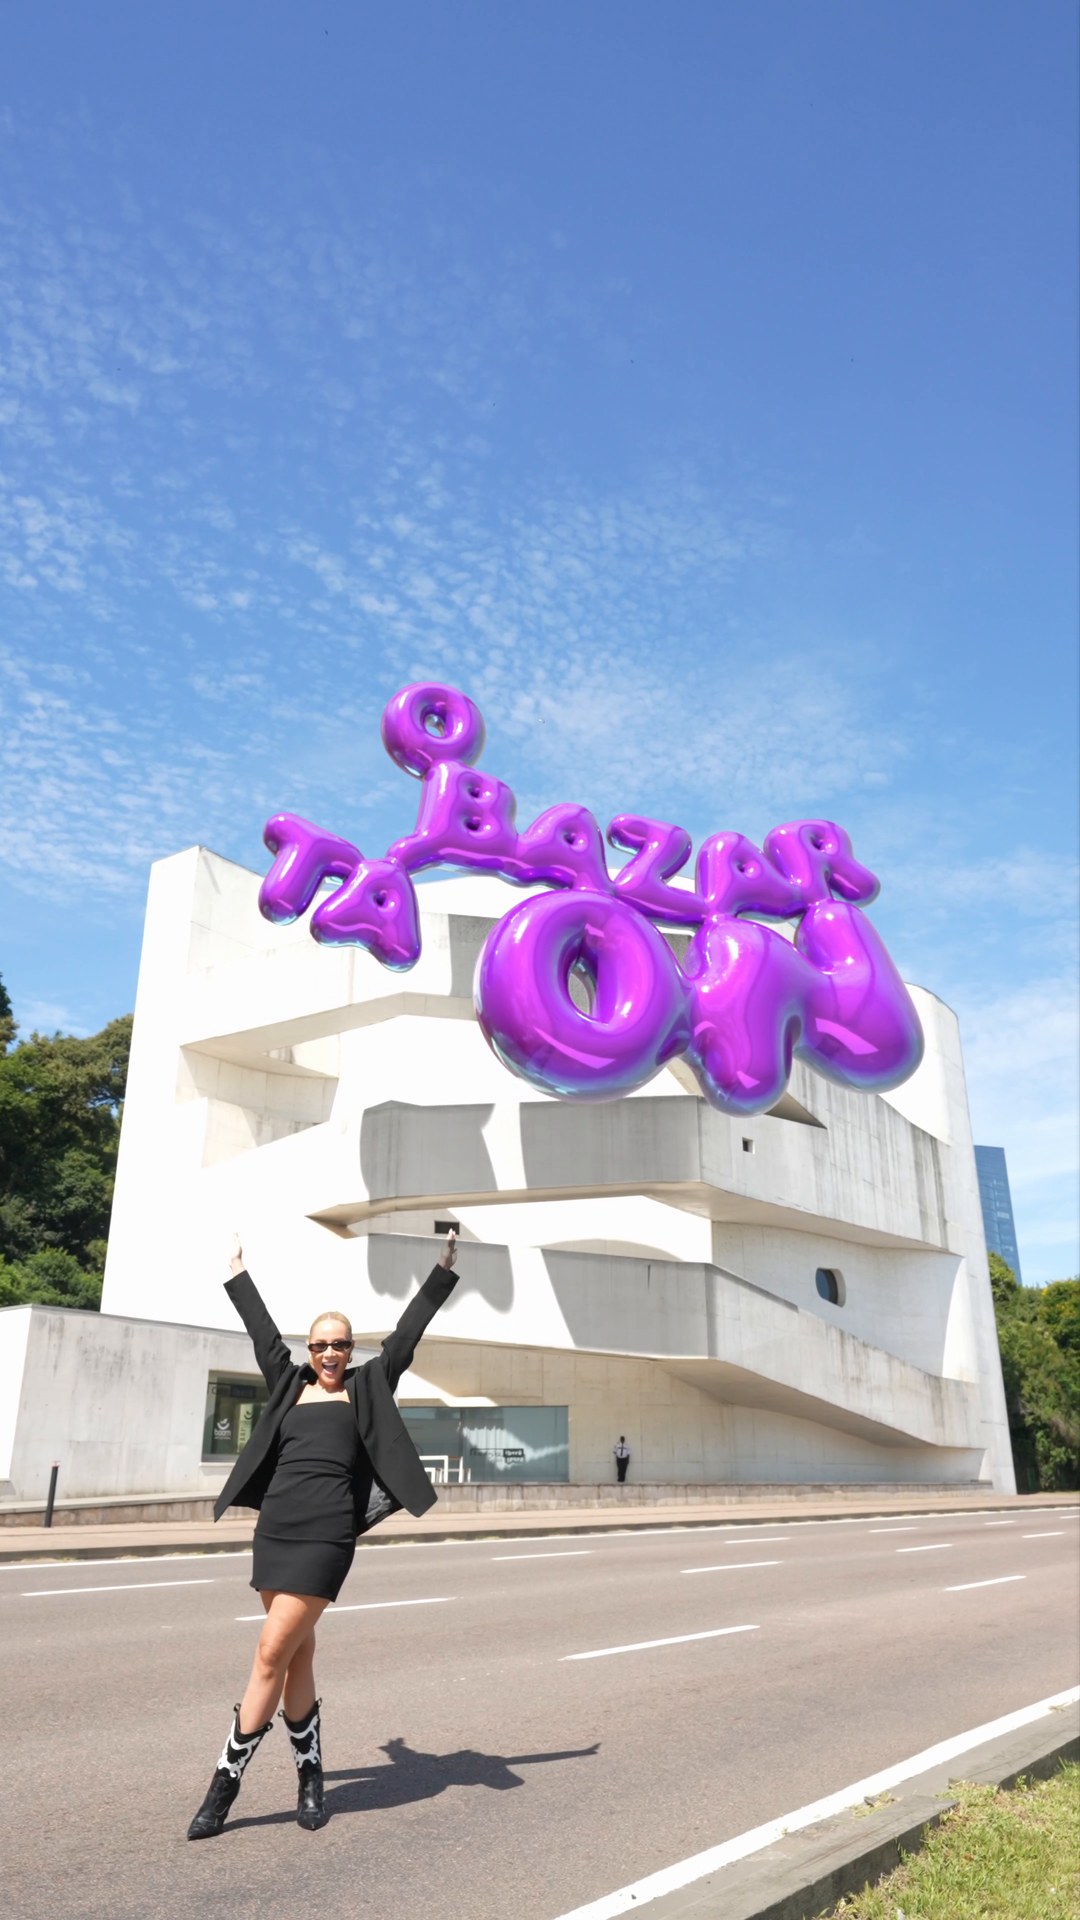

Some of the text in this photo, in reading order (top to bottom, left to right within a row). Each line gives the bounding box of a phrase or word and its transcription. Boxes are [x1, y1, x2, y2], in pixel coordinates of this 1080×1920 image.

[380, 682, 486, 781] O
[413, 760, 880, 930] BAZAR
[473, 886, 925, 1117] ON
